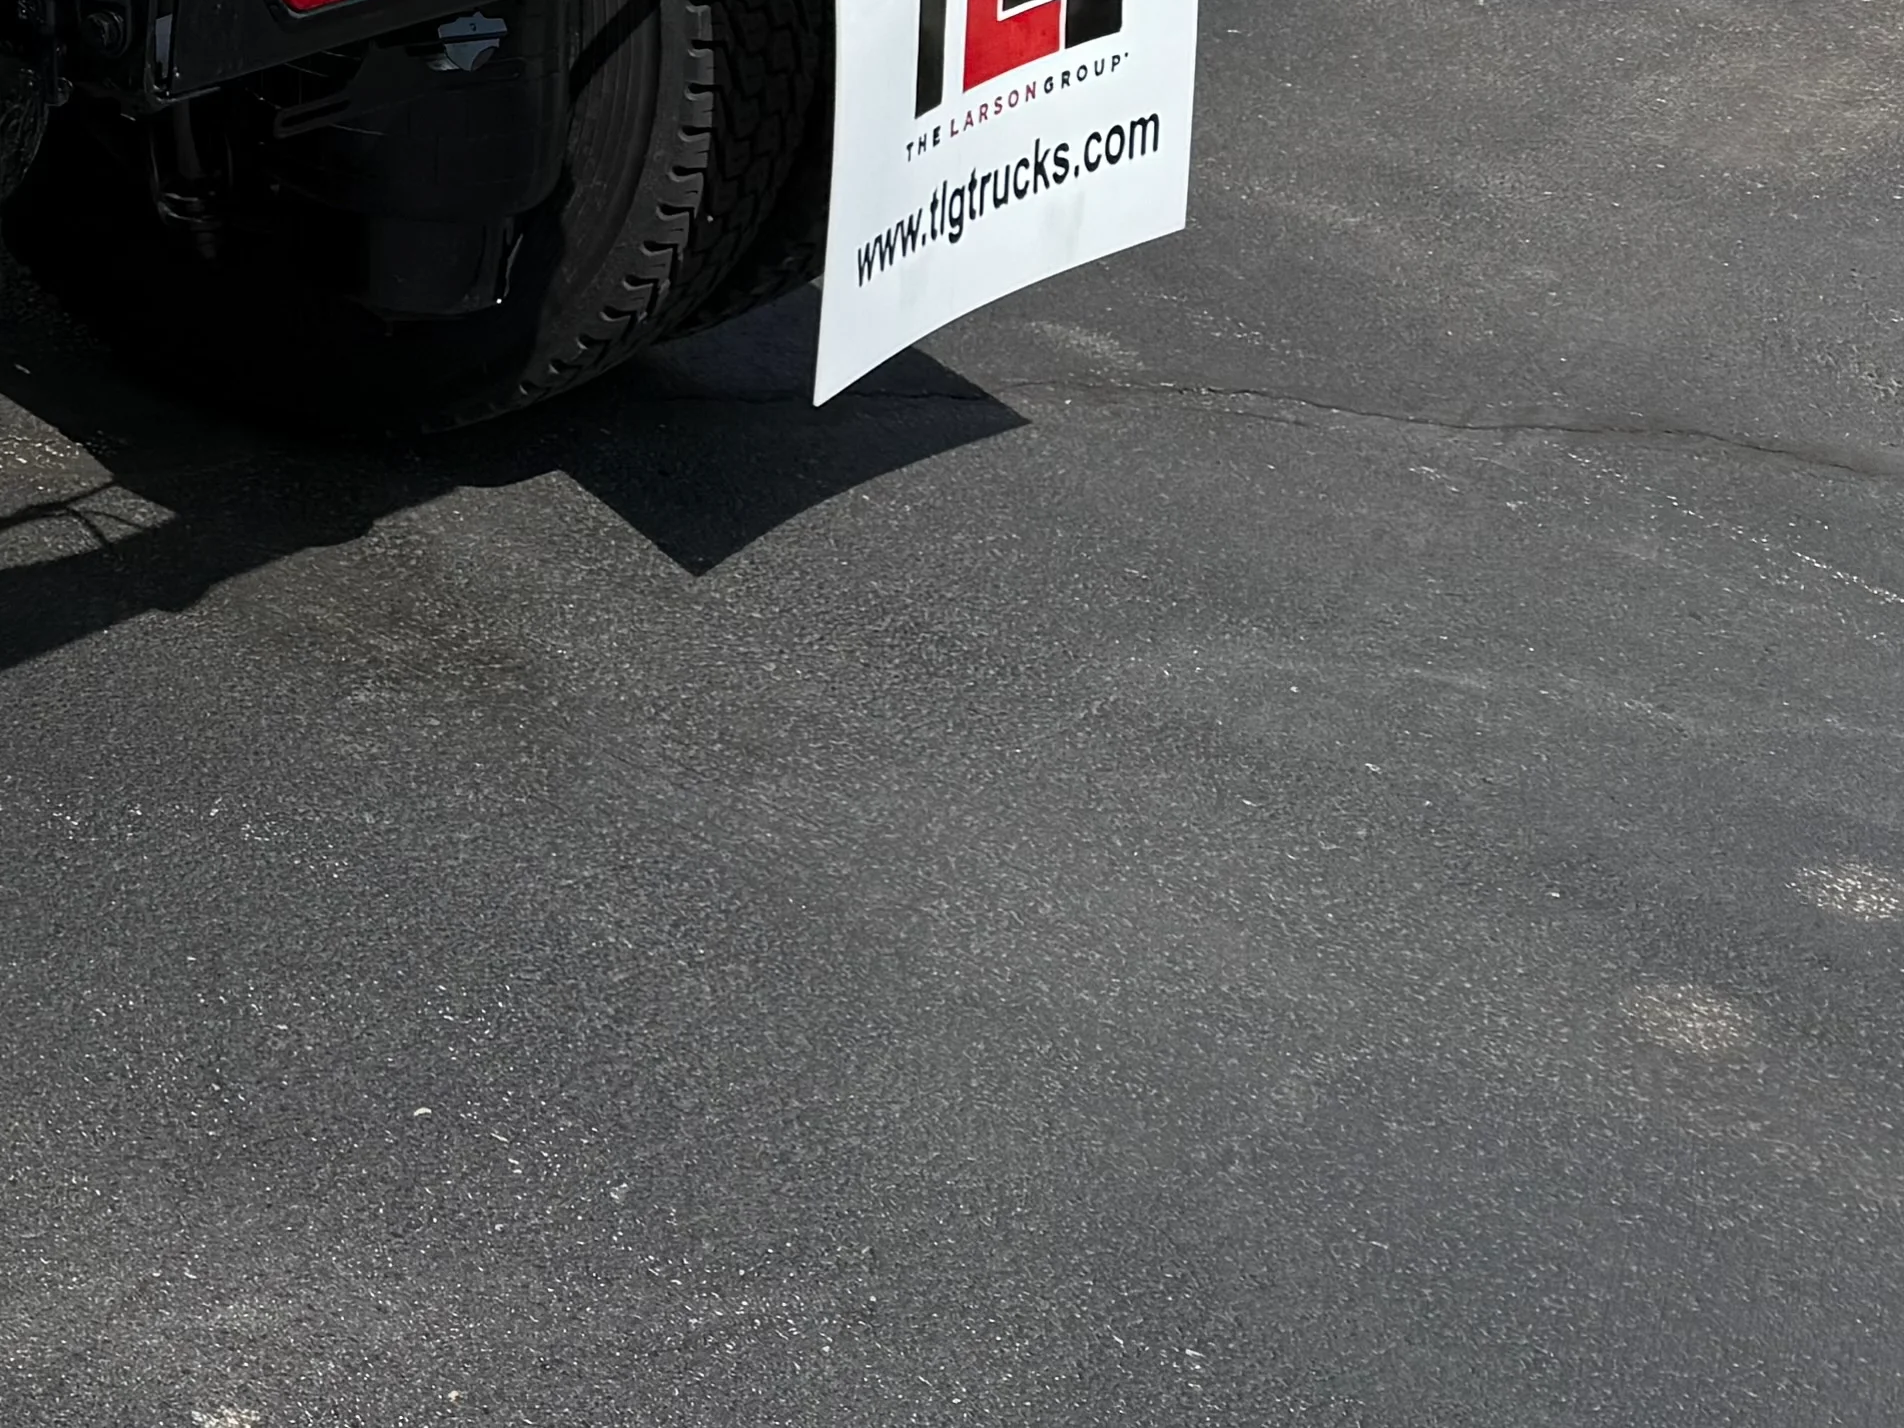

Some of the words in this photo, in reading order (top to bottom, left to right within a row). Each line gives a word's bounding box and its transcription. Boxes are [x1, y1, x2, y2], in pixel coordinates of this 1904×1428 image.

[906, 125, 941, 163] THE
[949, 81, 1037, 138] LARSON
[1043, 53, 1122, 95] GROUP
[856, 112, 1161, 288] www.tlgtrucks.com
